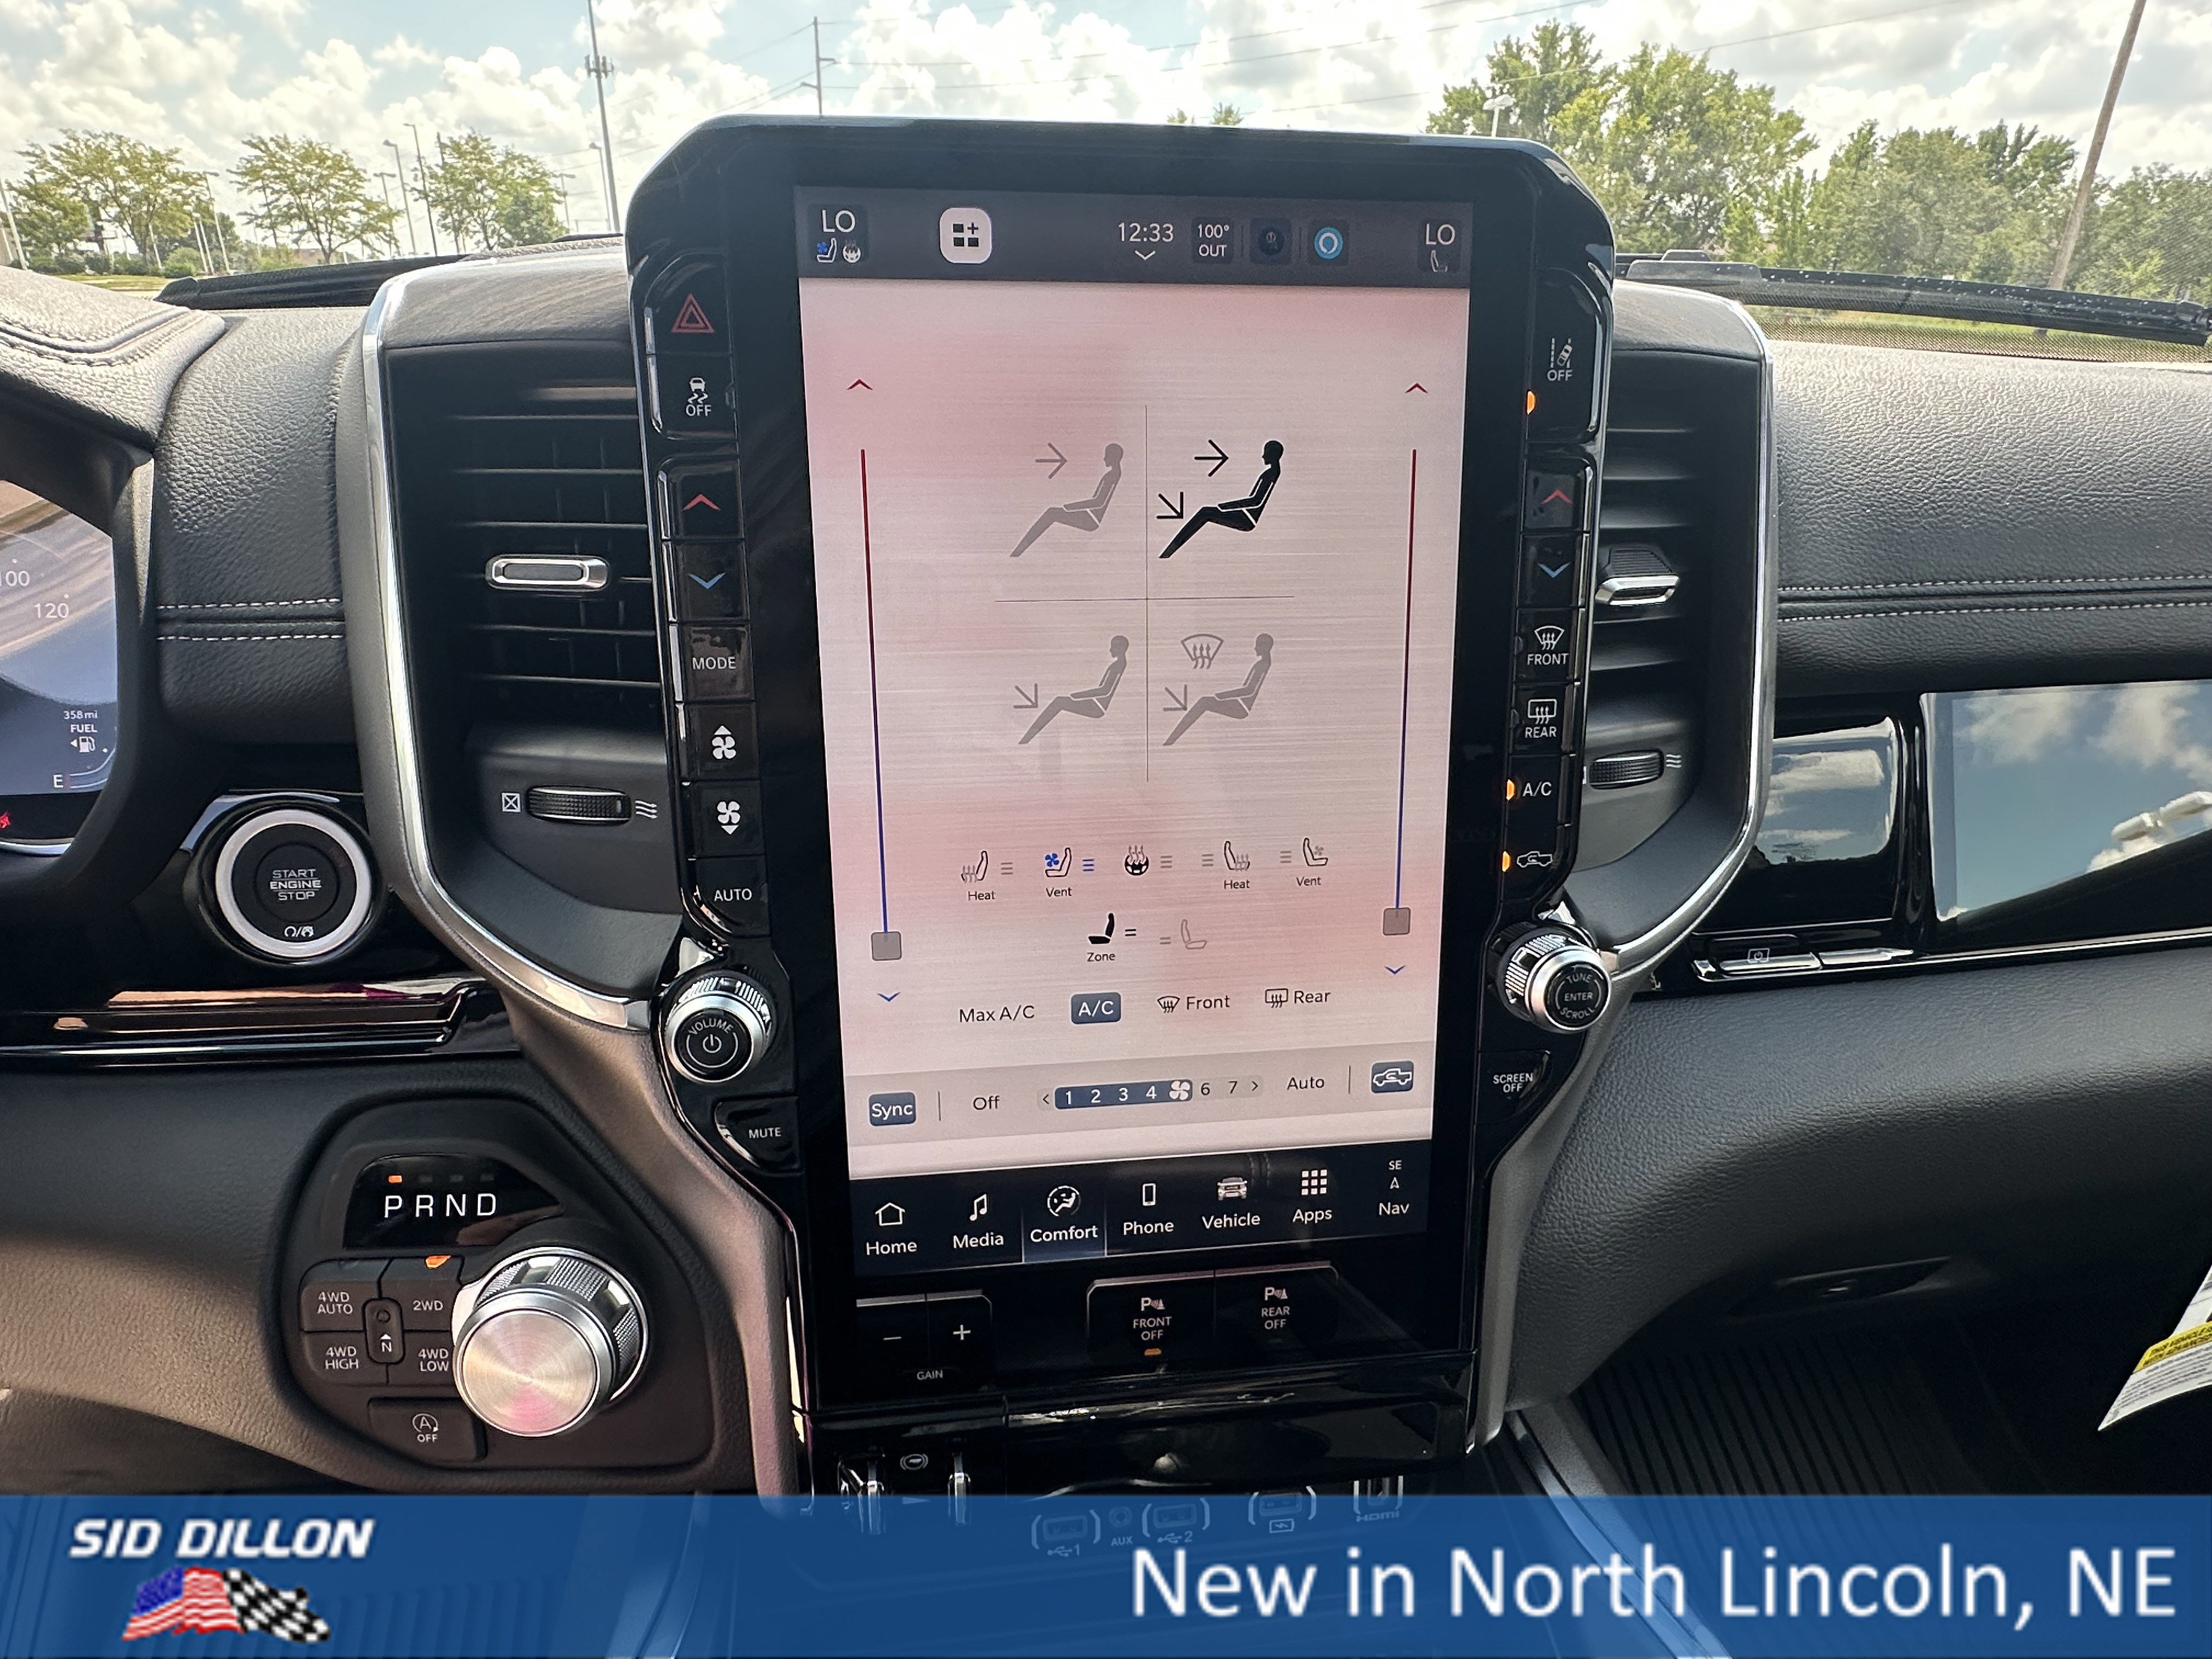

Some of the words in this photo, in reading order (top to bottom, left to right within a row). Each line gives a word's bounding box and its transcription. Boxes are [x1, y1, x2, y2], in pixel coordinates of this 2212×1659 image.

[822, 210, 856, 233] LO
[1118, 222, 1175, 243] 12:33
[1197, 224, 1230, 239] 100°
[1425, 224, 1456, 245] LO
[1198, 244, 1228, 258] OUT
[1547, 369, 1573, 381] OFF
[686, 403, 712, 417] OFF
[34, 602, 70, 619] 120
[692, 657, 737, 670] MODE
[1527, 653, 1569, 665] FRONT
[70, 724, 98, 733] FUEL
[1525, 726, 1557, 738] REAR
[53, 774, 64, 788] E
[1522, 781, 1552, 797] A/C
[272, 868, 317, 878] START
[269, 879, 321, 890] ENGINE
[1223, 879, 1251, 891] Heat
[1296, 876, 1322, 887] Vent
[278, 891, 315, 901] STOP
[714, 888, 753, 902] AUTO
[968, 889, 996, 901] Heat
[1045, 886, 1073, 899] Vent
[1086, 951, 1116, 963] Zone
[1566, 973, 1593, 984] TUNE
[1186, 994, 1231, 1010] Front
[1294, 989, 1331, 1005] Rear
[1564, 991, 1594, 1002] ENTER
[959, 1008, 996, 1023] Max
[999, 1005, 1035, 1022] A/C
[1078, 1001, 1115, 1018] A/C
[1559, 1007, 1595, 1020] SCROLL
[688, 1018, 734, 1036] VOLUME
[1286, 1075, 1325, 1091] Auto
[1492, 1073, 1533, 1084] SCREEN
[1065, 1091, 1072, 1104] 1
[1091, 1089, 1101, 1104] 2
[1118, 1087, 1128, 1102] 3
[1146, 1085, 1158, 1099] 4
[1200, 1082, 1211, 1096] 6
[1228, 1081, 1238, 1094] 7
[1503, 1083, 1523, 1093] OFF
[973, 1095, 1000, 1111] Off
[871, 1102, 913, 1120] Sync
[748, 1127, 782, 1139] MUTE
[1389, 1160, 1402, 1171] SE
[384, 1195, 403, 1218] P
[415, 1194, 435, 1217] R
[445, 1194, 467, 1217] N
[477, 1193, 497, 1217] D
[1378, 1202, 1410, 1216] Nav
[1201, 1211, 1261, 1229] Vehicle
[1292, 1209, 1333, 1226] Apps
[1030, 1224, 1098, 1243] Comfort
[1122, 1220, 1175, 1236] Phone
[952, 1232, 1005, 1249] Media
[866, 1240, 917, 1256] Home
[318, 1291, 350, 1304] 4WD
[317, 1302, 353, 1315] AUTO
[413, 1300, 444, 1312] 2WD
[1261, 1305, 1290, 1317] REAR
[1132, 1316, 1172, 1329] FRONT
[1263, 1318, 1287, 1330] OFF
[1140, 1329, 1164, 1341] OFF
[325, 1346, 357, 1358] 4WD
[381, 1341, 392, 1353] N
[417, 1348, 449, 1360] 4WD
[325, 1358, 359, 1370] HIGH
[420, 1360, 449, 1372] LOW
[916, 1369, 944, 1381] GAIN
[416, 1433, 438, 1443] OFF
[1110, 1536, 1133, 1547] AUX
